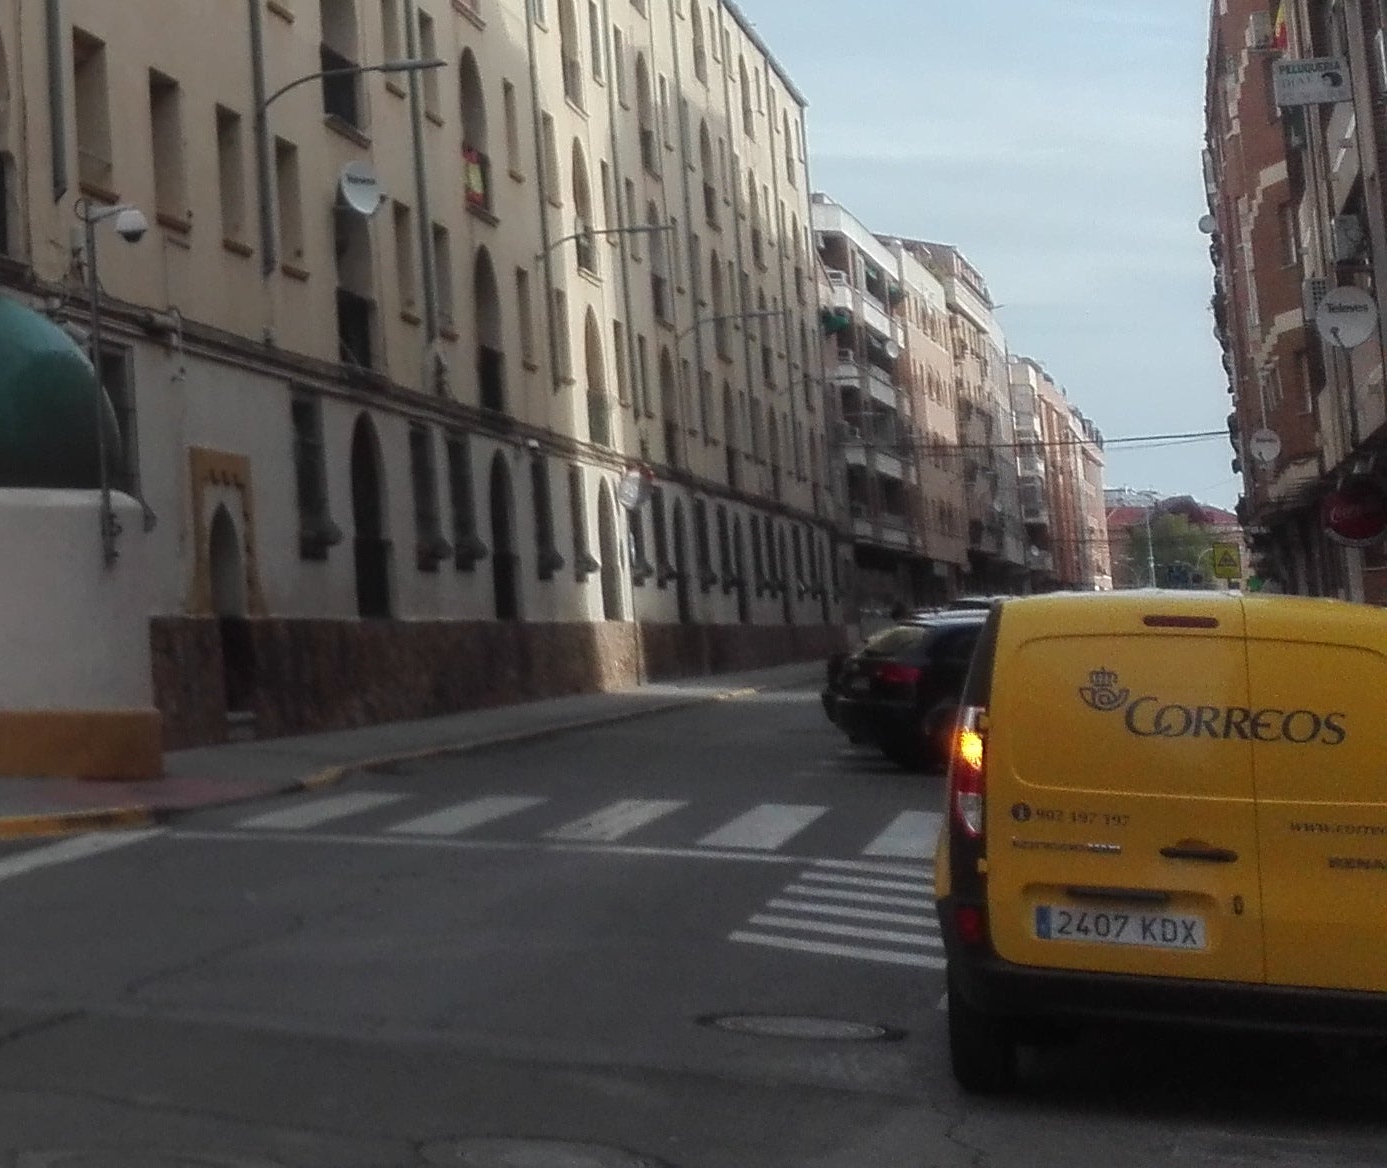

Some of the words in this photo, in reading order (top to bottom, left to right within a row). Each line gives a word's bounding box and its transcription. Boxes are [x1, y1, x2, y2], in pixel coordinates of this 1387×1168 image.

[1124, 695, 1346, 746] CORREOS
[1057, 910, 1130, 938] 2407
[1140, 915, 1197, 945] KDX
